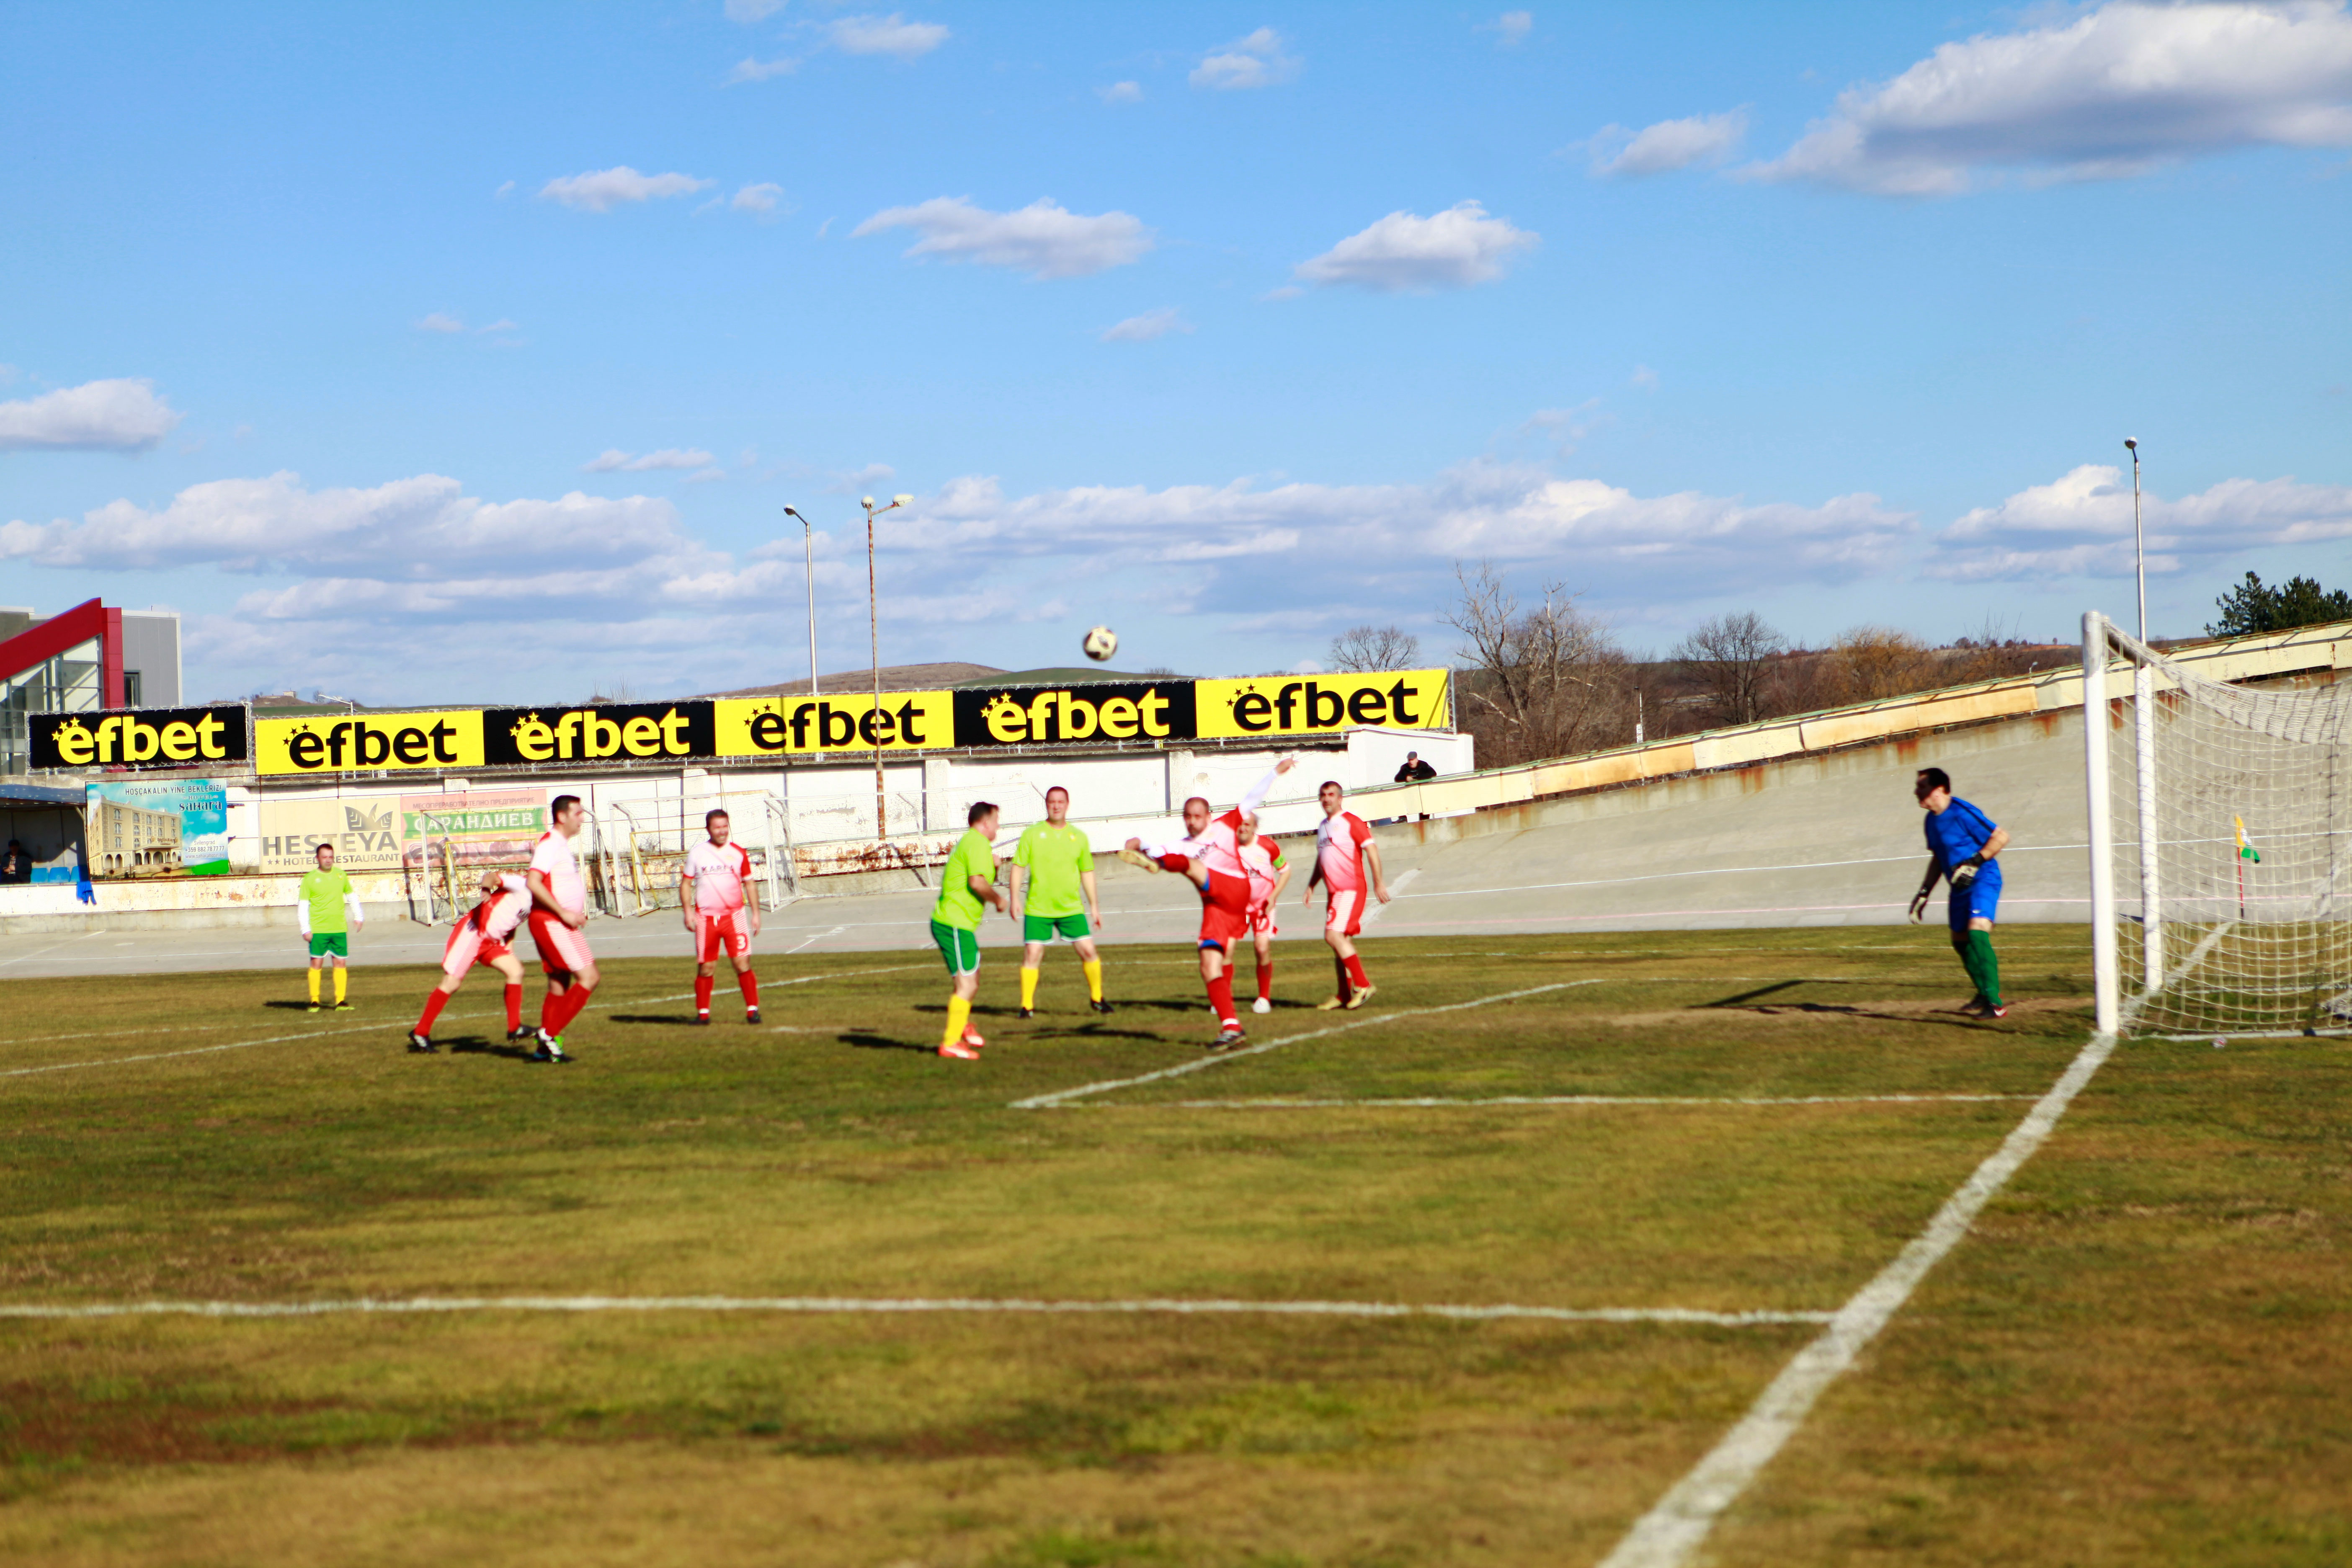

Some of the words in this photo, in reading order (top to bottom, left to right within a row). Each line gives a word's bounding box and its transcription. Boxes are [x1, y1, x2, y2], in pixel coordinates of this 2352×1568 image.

[751, 701, 925, 748] efbet
[988, 689, 1169, 742] efbet
[1234, 679, 1418, 730] efbet
[58, 713, 225, 763] efbet
[289, 720, 456, 767] efbet
[516, 708, 689, 759] efbet
[126, 787, 167, 796] HOŞÇAKALIN
[188, 784, 222, 793] BEKLERİZ!
[413, 800, 489, 809] МЕСОПРЕРАБОТВАТЕЛНО
[263, 832, 399, 856] HESTEYA
[333, 854, 400, 864] ESTAURANT
[736, 934, 746, 949] 3
